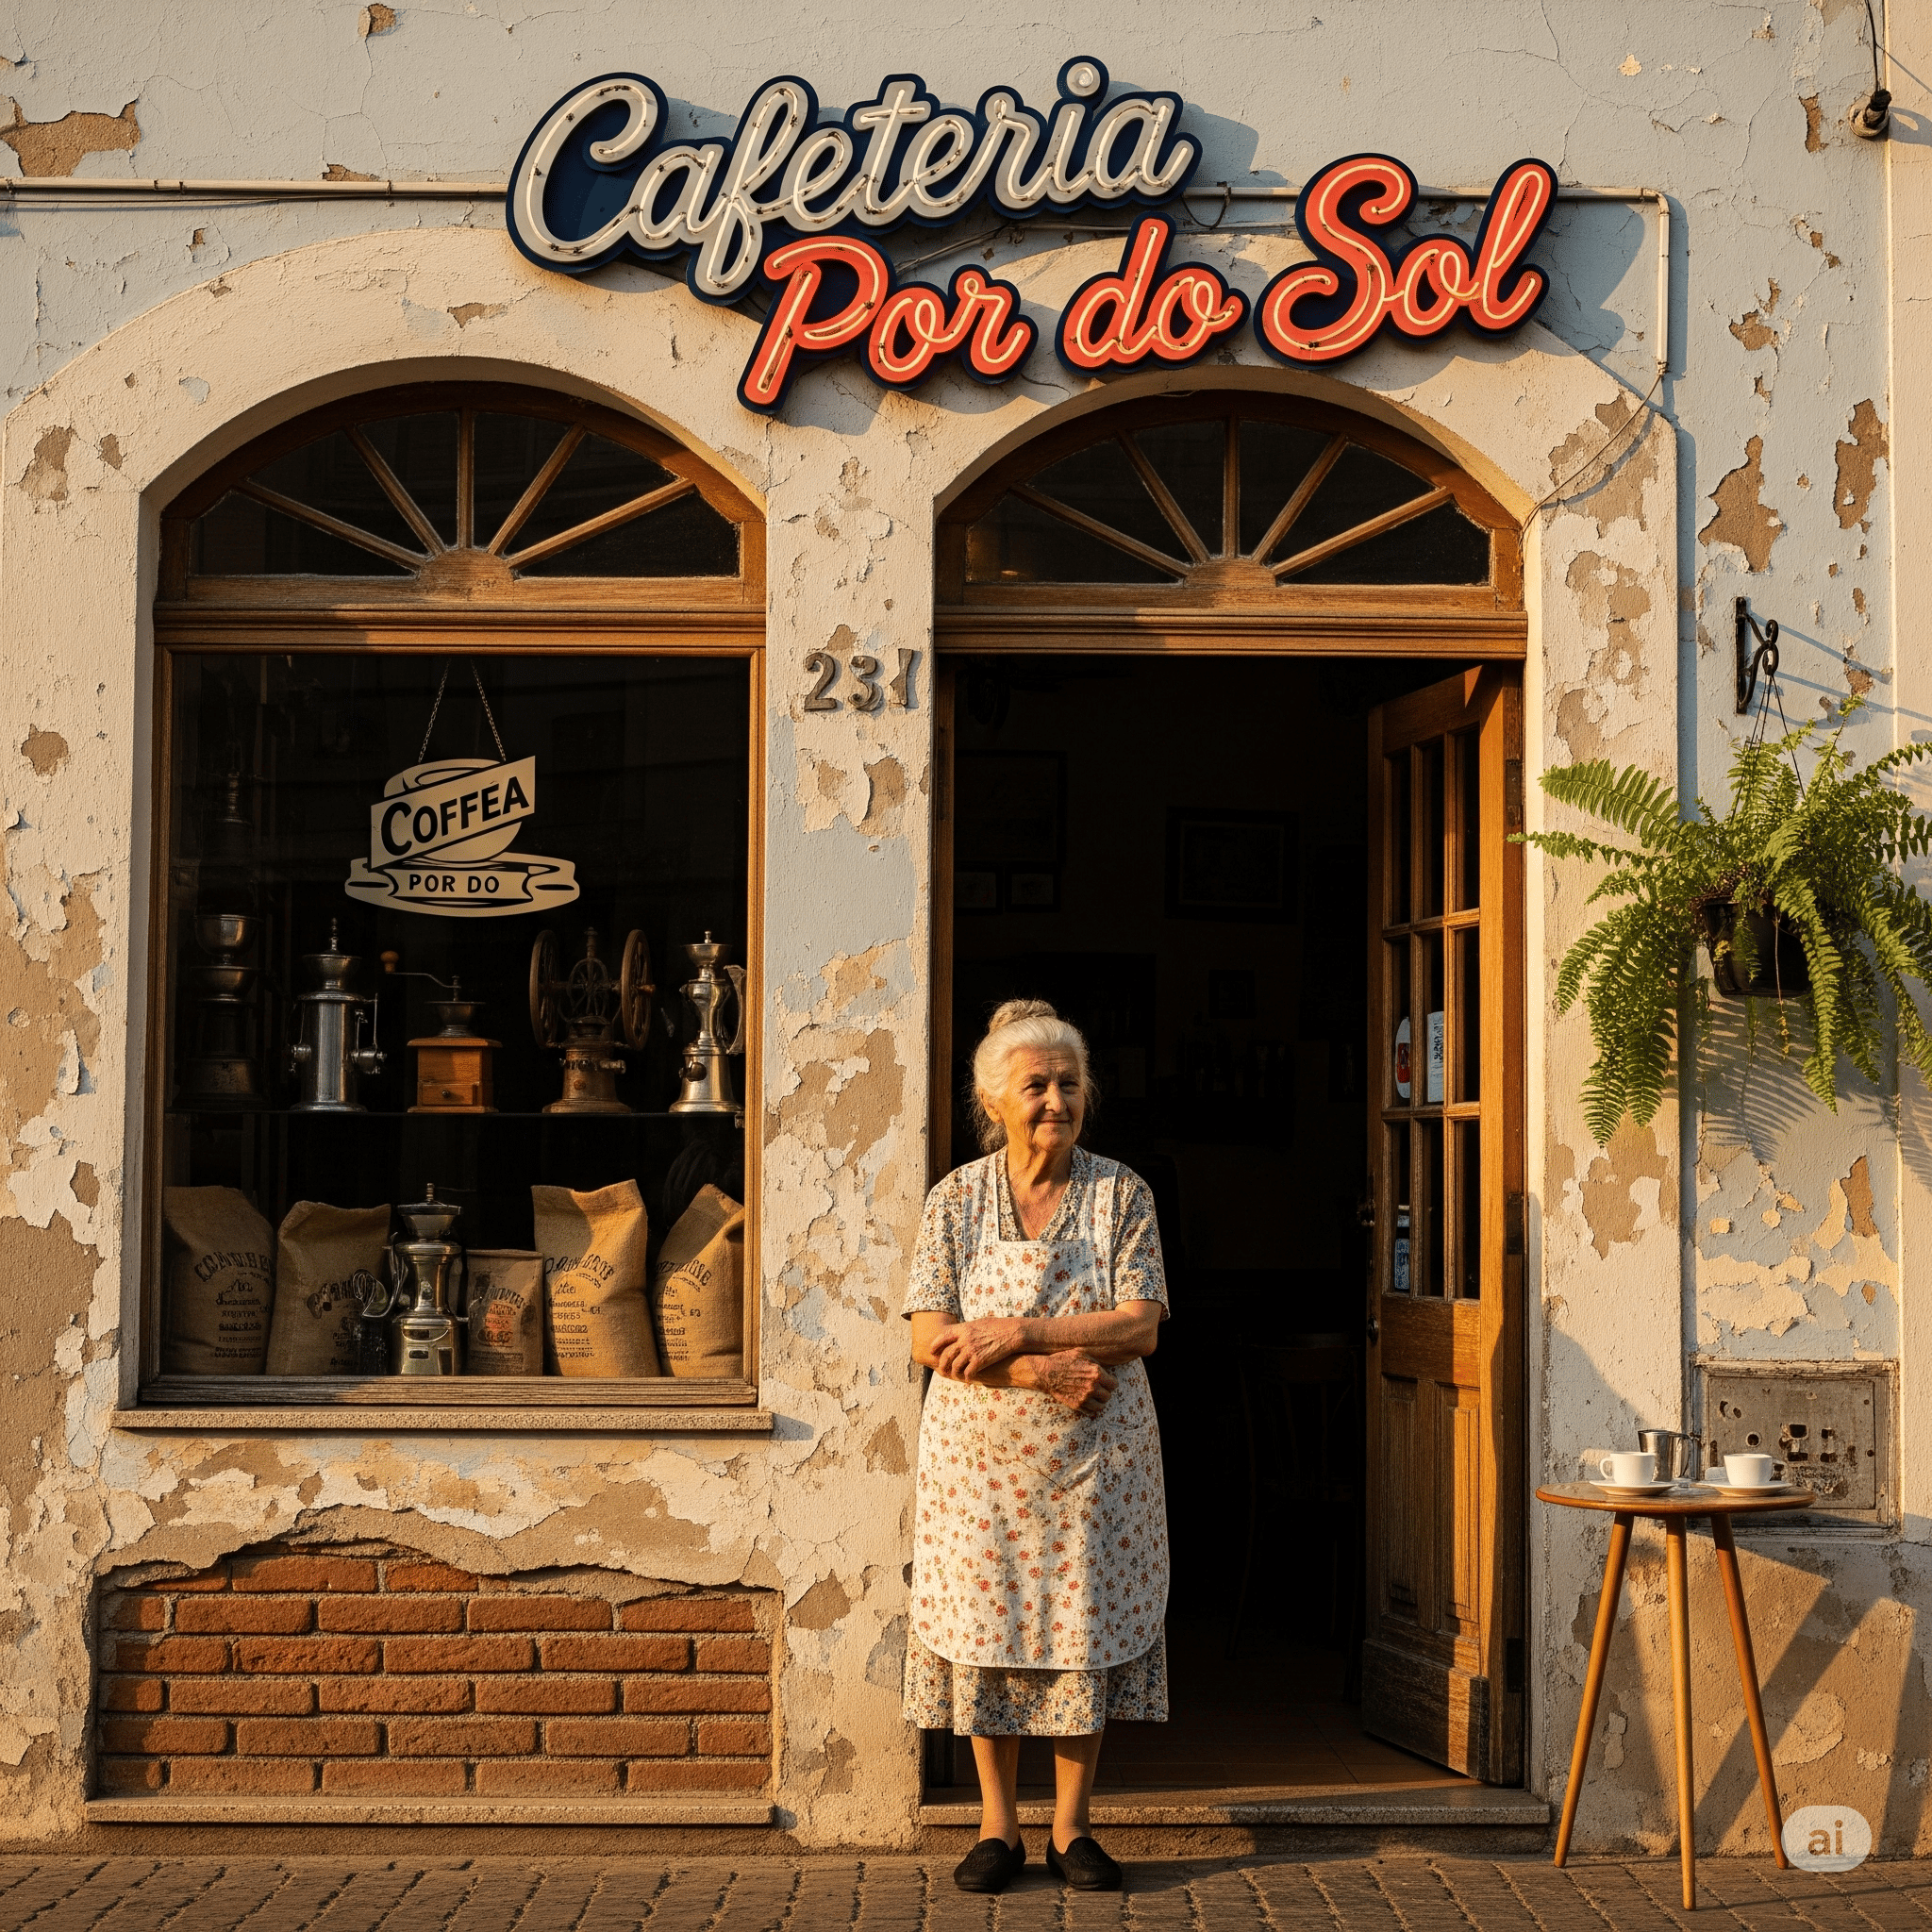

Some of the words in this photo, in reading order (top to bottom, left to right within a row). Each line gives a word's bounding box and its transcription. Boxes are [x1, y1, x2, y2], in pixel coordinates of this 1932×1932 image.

[512, 61, 1194, 296] Cafeteria
[743, 235, 1034, 406] Por
[1062, 217, 1244, 365] do
[1260, 157, 1554, 362] Sol
[804, 647, 914, 712] 231
[380, 775, 530, 857] COFFEA
[408, 874, 456, 892] POR
[467, 875, 501, 893] DO
